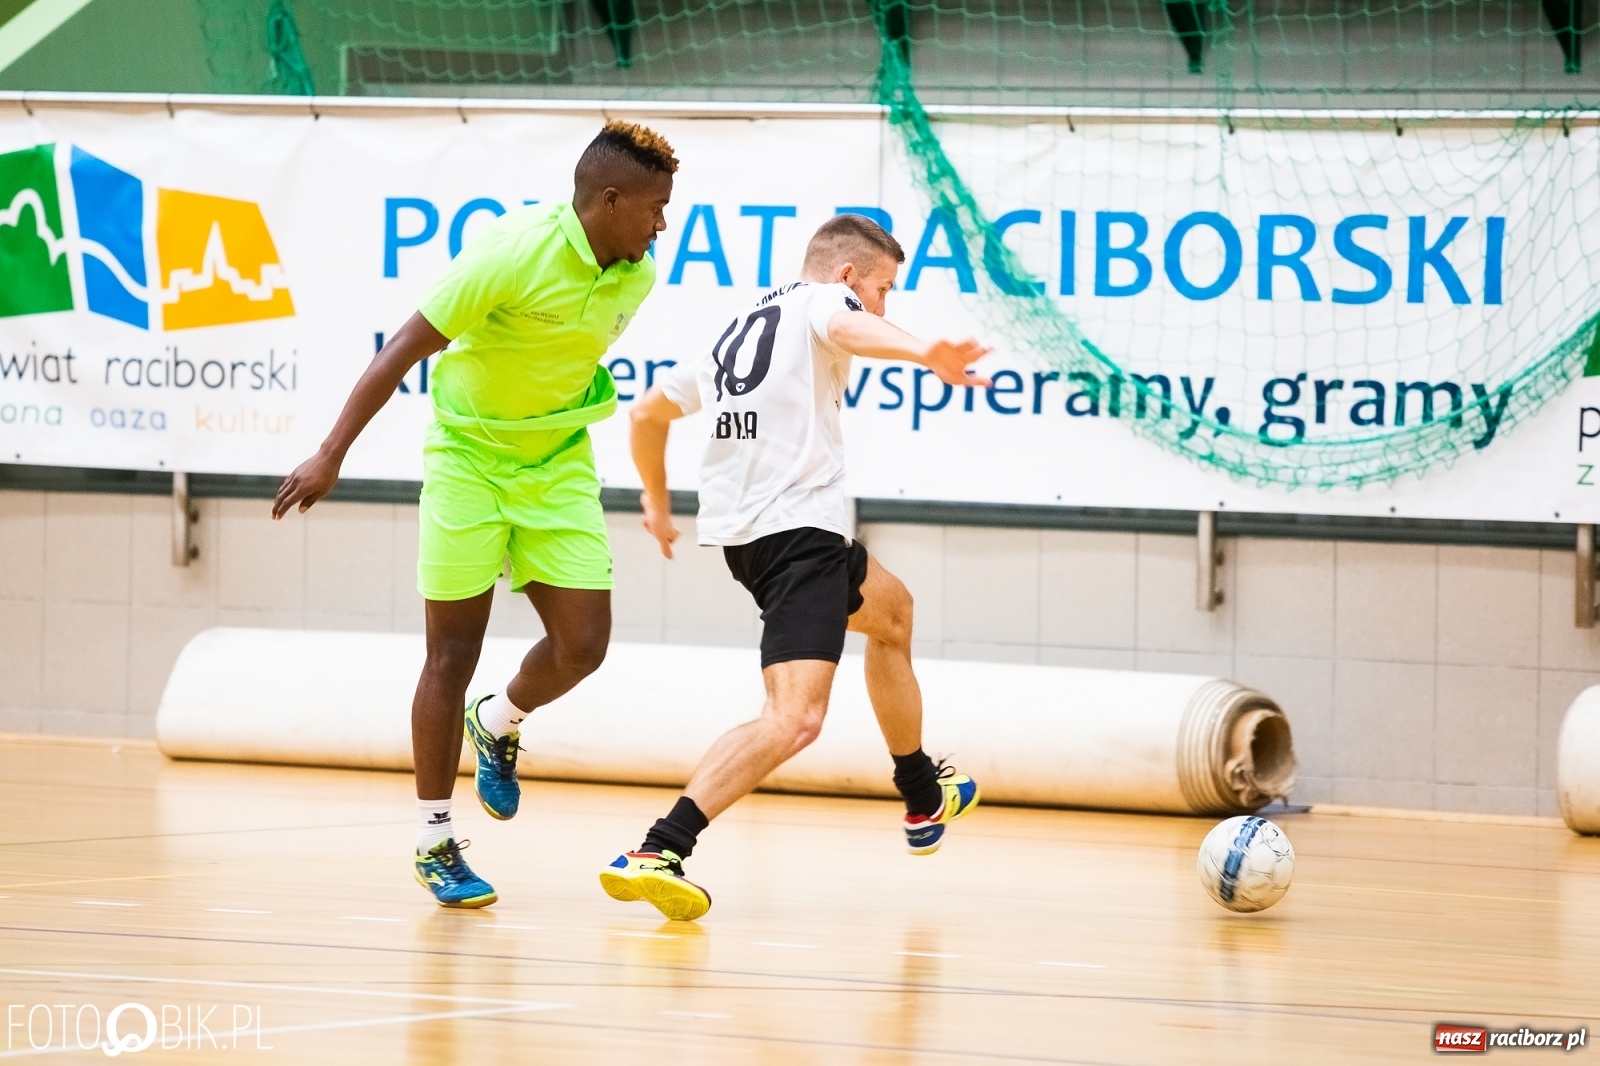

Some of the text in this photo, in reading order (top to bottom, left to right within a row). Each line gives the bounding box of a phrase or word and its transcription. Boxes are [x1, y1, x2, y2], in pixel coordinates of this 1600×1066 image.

[383, 197, 797, 288] POAT
[0, 340, 298, 391] wiat raciborski
[0, 403, 297, 434] ona oaza kultur
[1259, 372, 1513, 450] gramy
